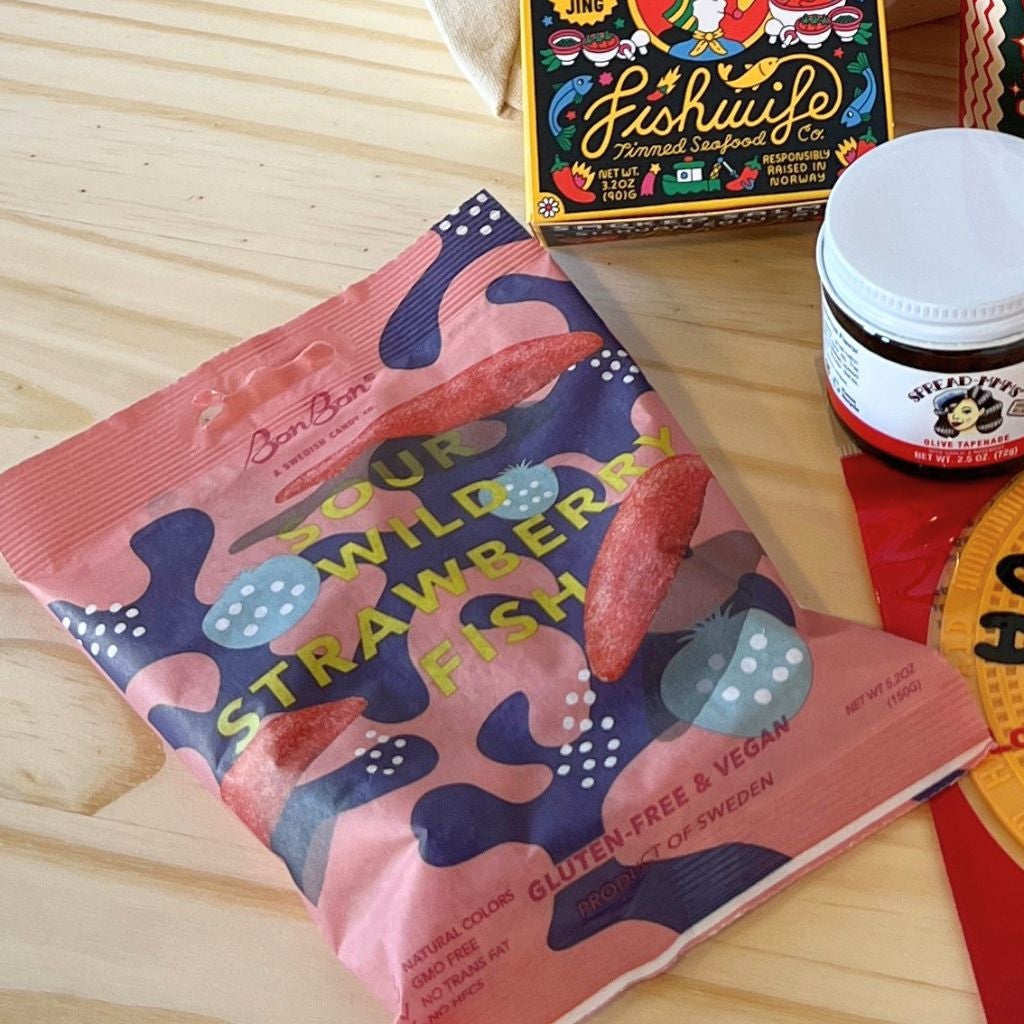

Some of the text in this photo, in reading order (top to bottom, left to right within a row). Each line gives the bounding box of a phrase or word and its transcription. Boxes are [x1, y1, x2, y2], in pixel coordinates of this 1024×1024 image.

[581, 53, 842, 159] Fishwife
[612, 123, 825, 160] Tinned Seafood Co.
[762, 149, 830, 165] RESPONSIBLY
[767, 162, 827, 175] RAISED IN
[598, 166, 640, 179] NET WT.
[769, 173, 826, 187] NORWAY
[272, 469, 282, 478] A
[282, 439, 327, 471] SWEDISH
[329, 415, 360, 439] CANDY
[914, 451, 934, 461] NET
[924, 434, 1010, 448] OLIVE TAPENADE
[277, 427, 481, 553] SOUR
[316, 479, 509, 583] WILD
[217, 426, 678, 756] STRAWBERRY
[419, 571, 586, 698] FISH
[845, 694, 865, 716] NET
[865, 682, 884, 701] WT
[528, 714, 791, 903] GLUTEN-FREE & VEGAN
[667, 823, 692, 850] OF
[697, 770, 774, 831] SWEDEN
[402, 889, 515, 973] NATURAL COLORS
[411, 937, 480, 990] GMO FREE
[421, 937, 512, 1009] NO TRANS FAT
[428, 979, 486, 1024] NO HFCS
